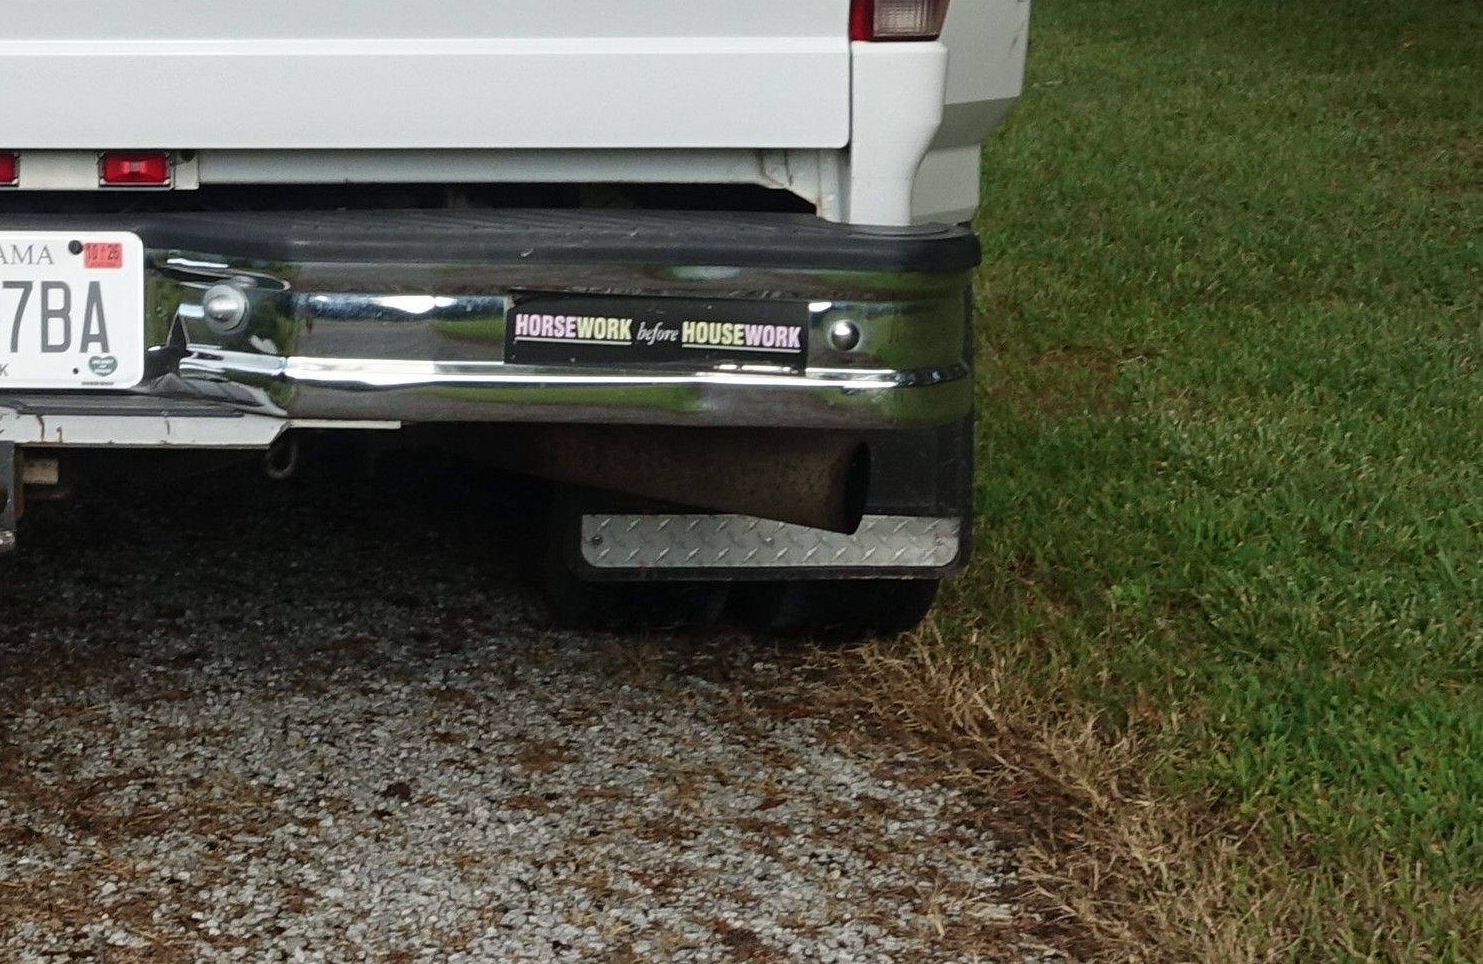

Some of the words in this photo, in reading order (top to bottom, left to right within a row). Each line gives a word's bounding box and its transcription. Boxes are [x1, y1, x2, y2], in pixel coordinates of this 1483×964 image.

[515, 313, 633, 340] HORSEWORK
[636, 322, 679, 346] before
[681, 321, 801, 348] HOUSEWORK
